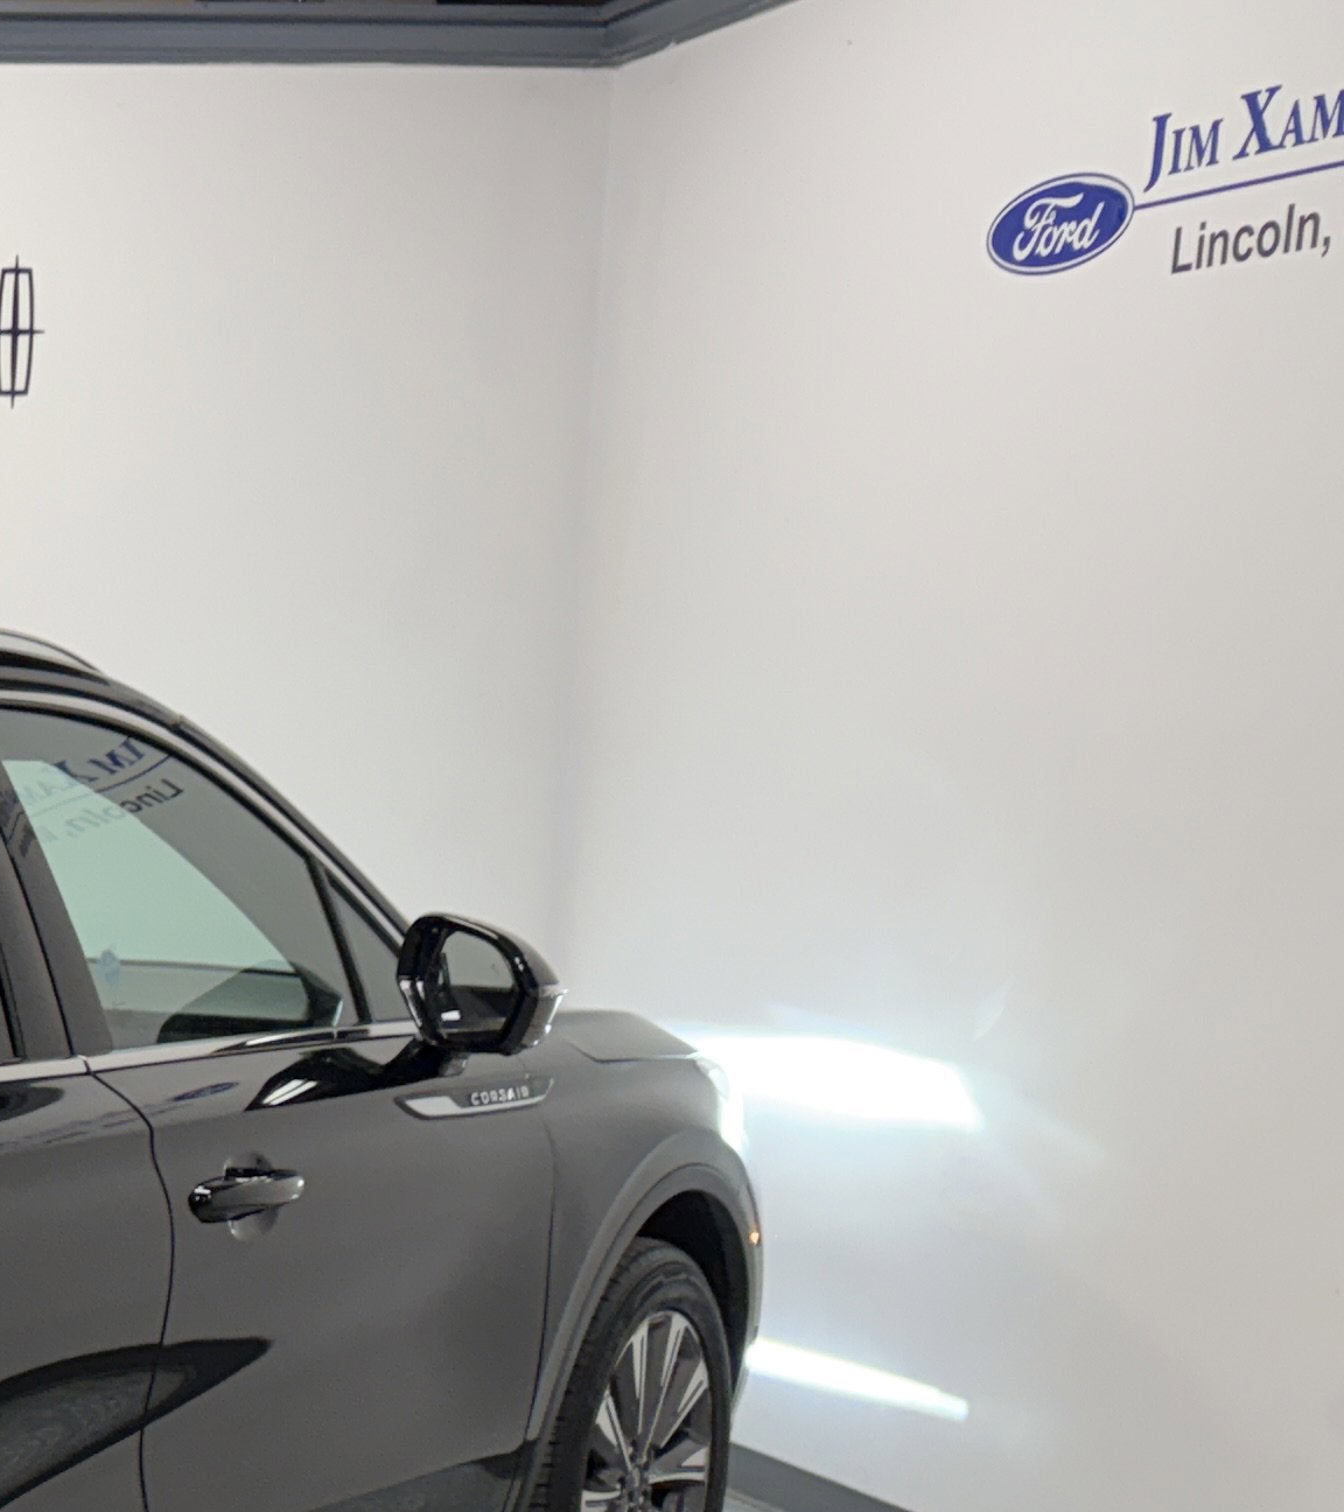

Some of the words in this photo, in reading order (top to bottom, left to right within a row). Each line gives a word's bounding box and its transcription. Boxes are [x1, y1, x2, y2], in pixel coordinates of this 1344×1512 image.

[1143, 112, 1224, 193] JIM
[1012, 191, 1106, 263] Ford
[1171, 203, 1332, 275] Lincoln,
